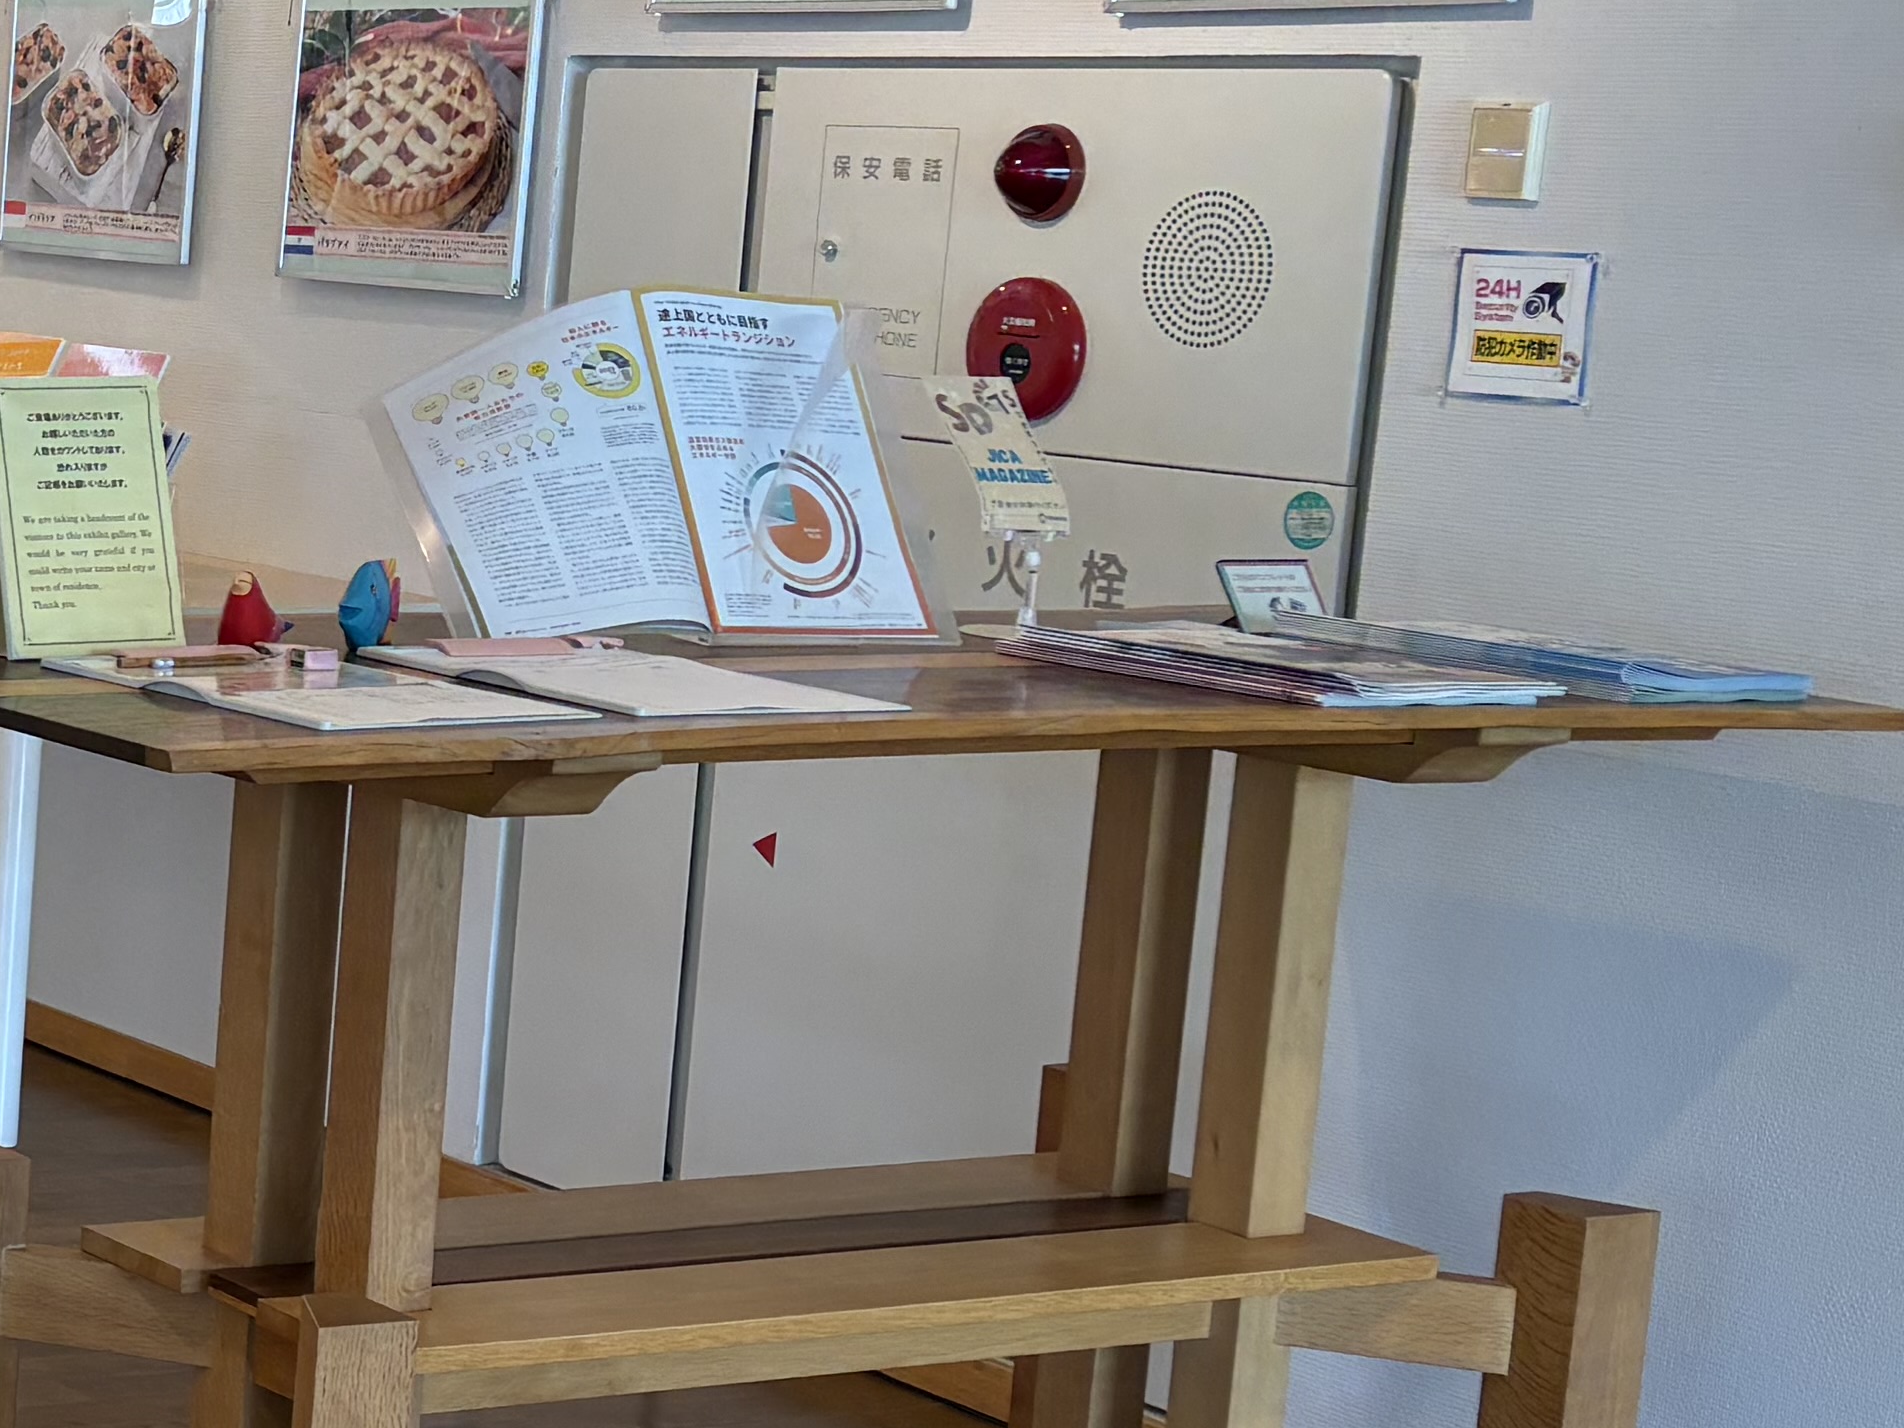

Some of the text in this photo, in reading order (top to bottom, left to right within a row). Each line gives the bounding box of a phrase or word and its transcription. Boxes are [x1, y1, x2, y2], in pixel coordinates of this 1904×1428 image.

[833, 155, 943, 182] 保安電話
[1475, 278, 1522, 299] 24H
[657, 308, 770, 330] 途上国とともに目指す
[662, 326, 796, 348] エネルギートランジション
[988, 449, 1023, 464] JICA
[974, 468, 1054, 484] MAGAZINE
